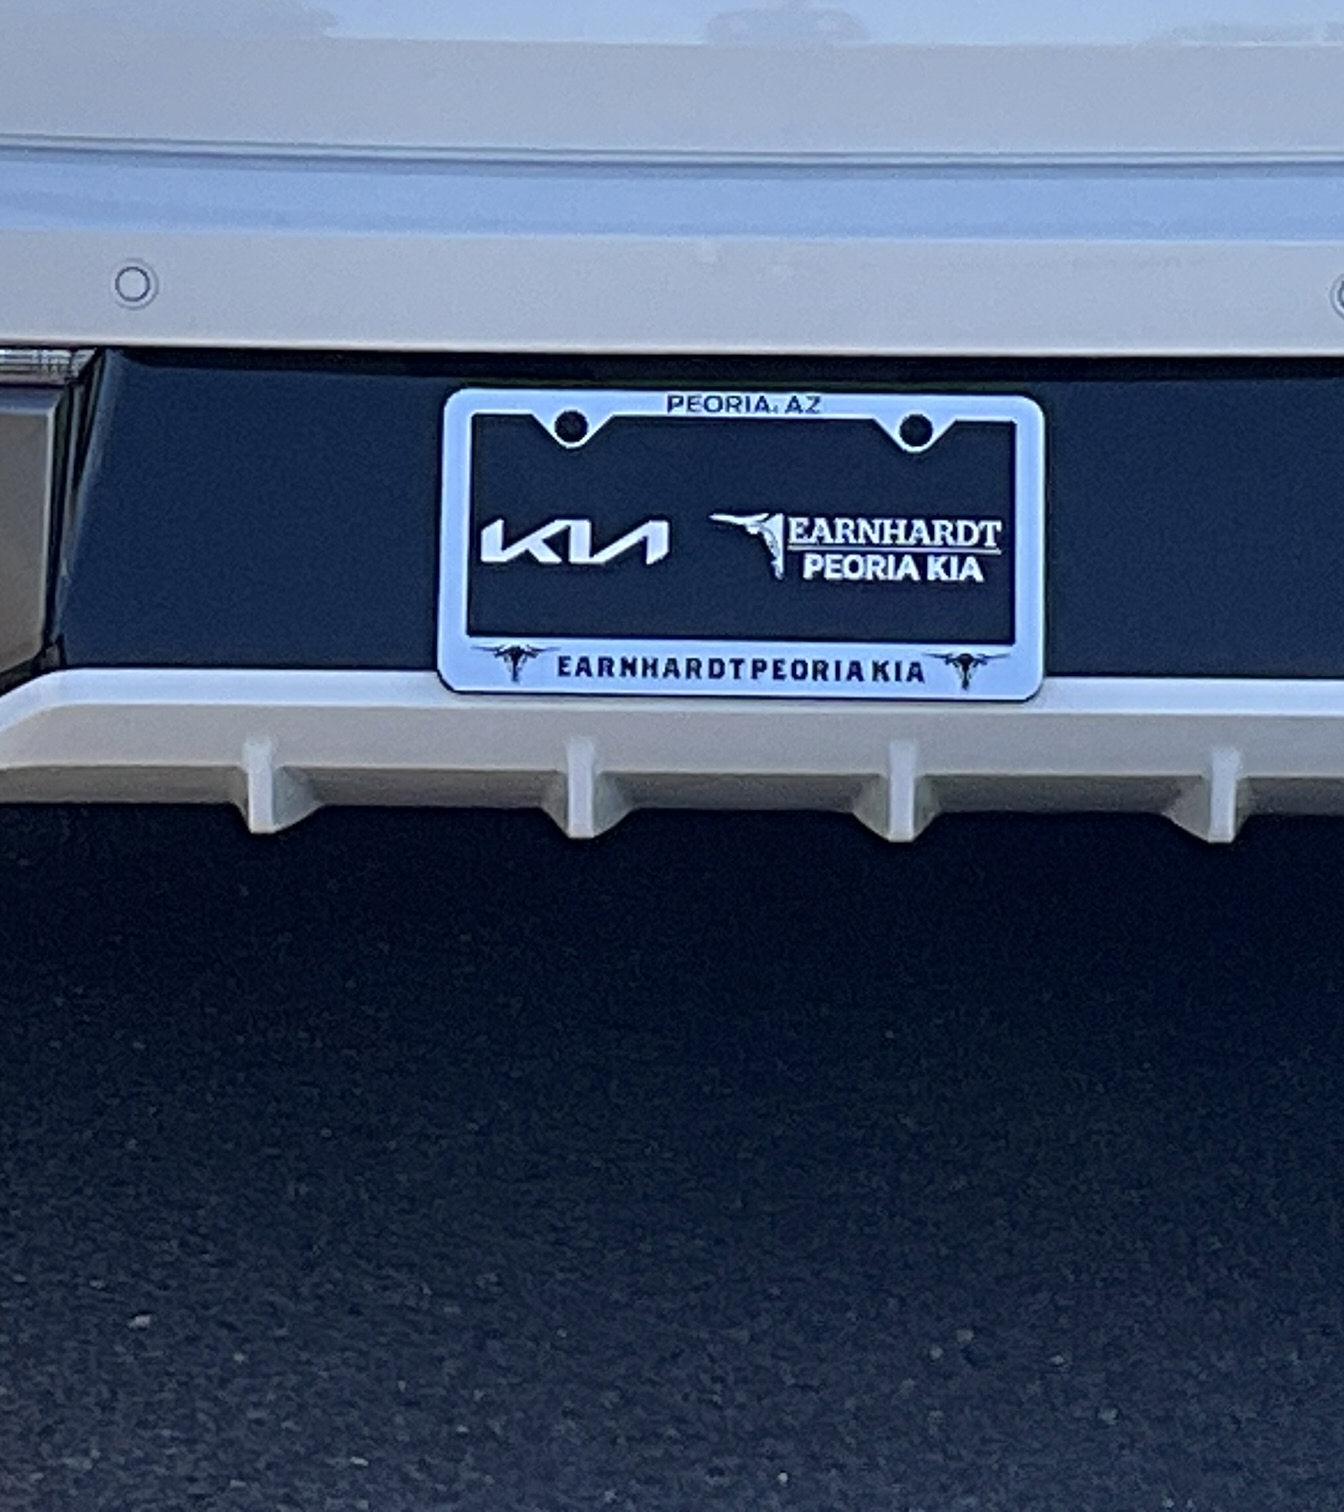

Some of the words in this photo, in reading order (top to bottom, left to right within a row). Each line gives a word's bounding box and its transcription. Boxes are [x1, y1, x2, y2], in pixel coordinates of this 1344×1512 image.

[784, 395, 821, 414] AZ
[787, 516, 1002, 547] EARNHARDT
[803, 554, 920, 581] PEORIA
[926, 555, 984, 582] KIA
